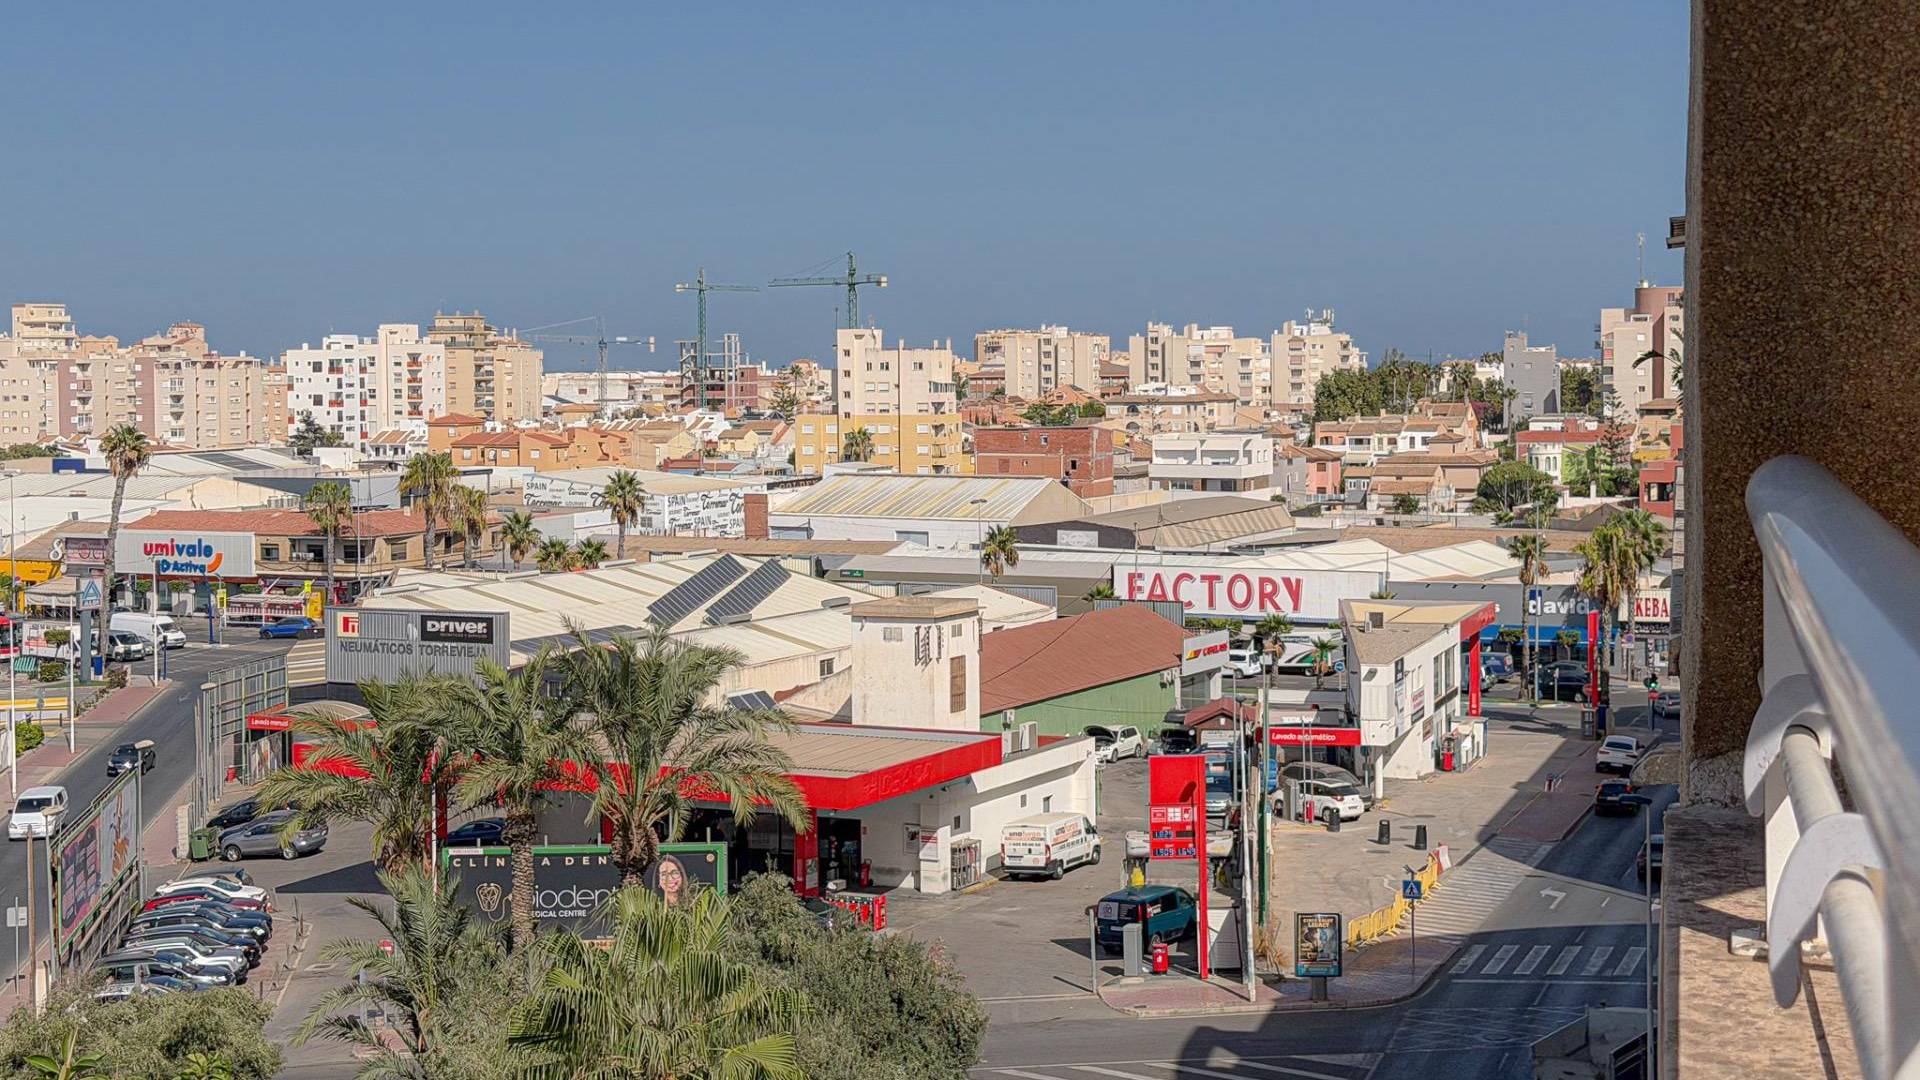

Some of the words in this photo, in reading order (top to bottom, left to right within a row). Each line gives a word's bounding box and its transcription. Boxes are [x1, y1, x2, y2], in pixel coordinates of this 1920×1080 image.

[526, 482, 547, 491] SPAIN
[668, 495, 686, 507] SPAIN
[1128, 573, 1303, 613] FACTORY
[1528, 598, 1589, 615] david
[1635, 597, 1669, 617] KEBA
[340, 640, 413, 655] NEUMÁTICOS
[418, 644, 487, 658] TORREVIEJA
[453, 856, 550, 867] CLÍNA
[565, 856, 608, 866] DEN
[533, 885, 617, 908] iodent
[532, 910, 557, 918] EDICAL
[559, 909, 587, 917] CENTRE
